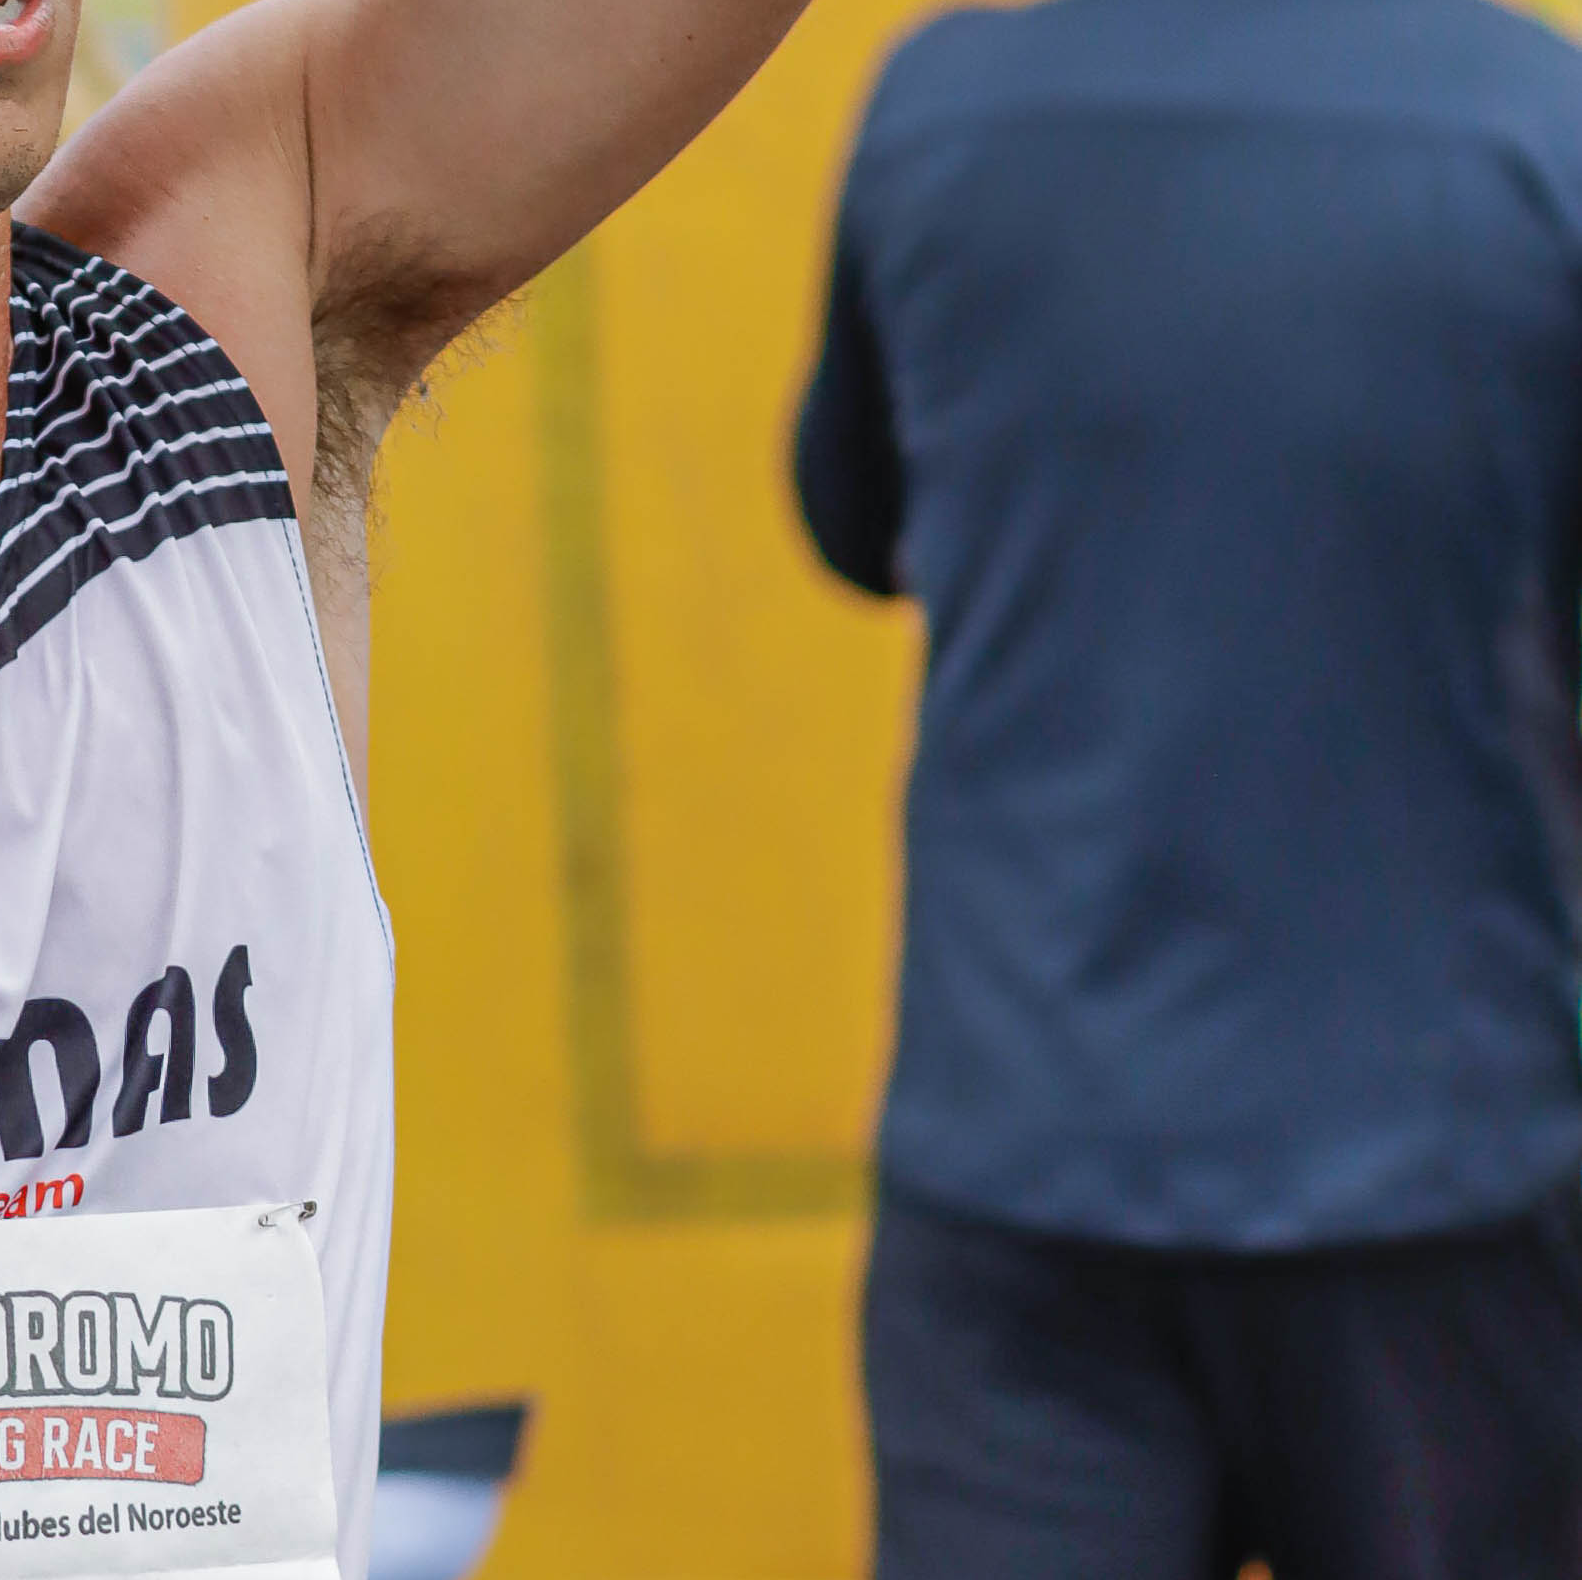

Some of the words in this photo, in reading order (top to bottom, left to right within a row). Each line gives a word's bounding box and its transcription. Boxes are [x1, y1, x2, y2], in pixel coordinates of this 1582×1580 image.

[40, 1416, 160, 1479] RACE
[78, 1502, 120, 1535] del
[127, 1500, 242, 1532] Noroeste
